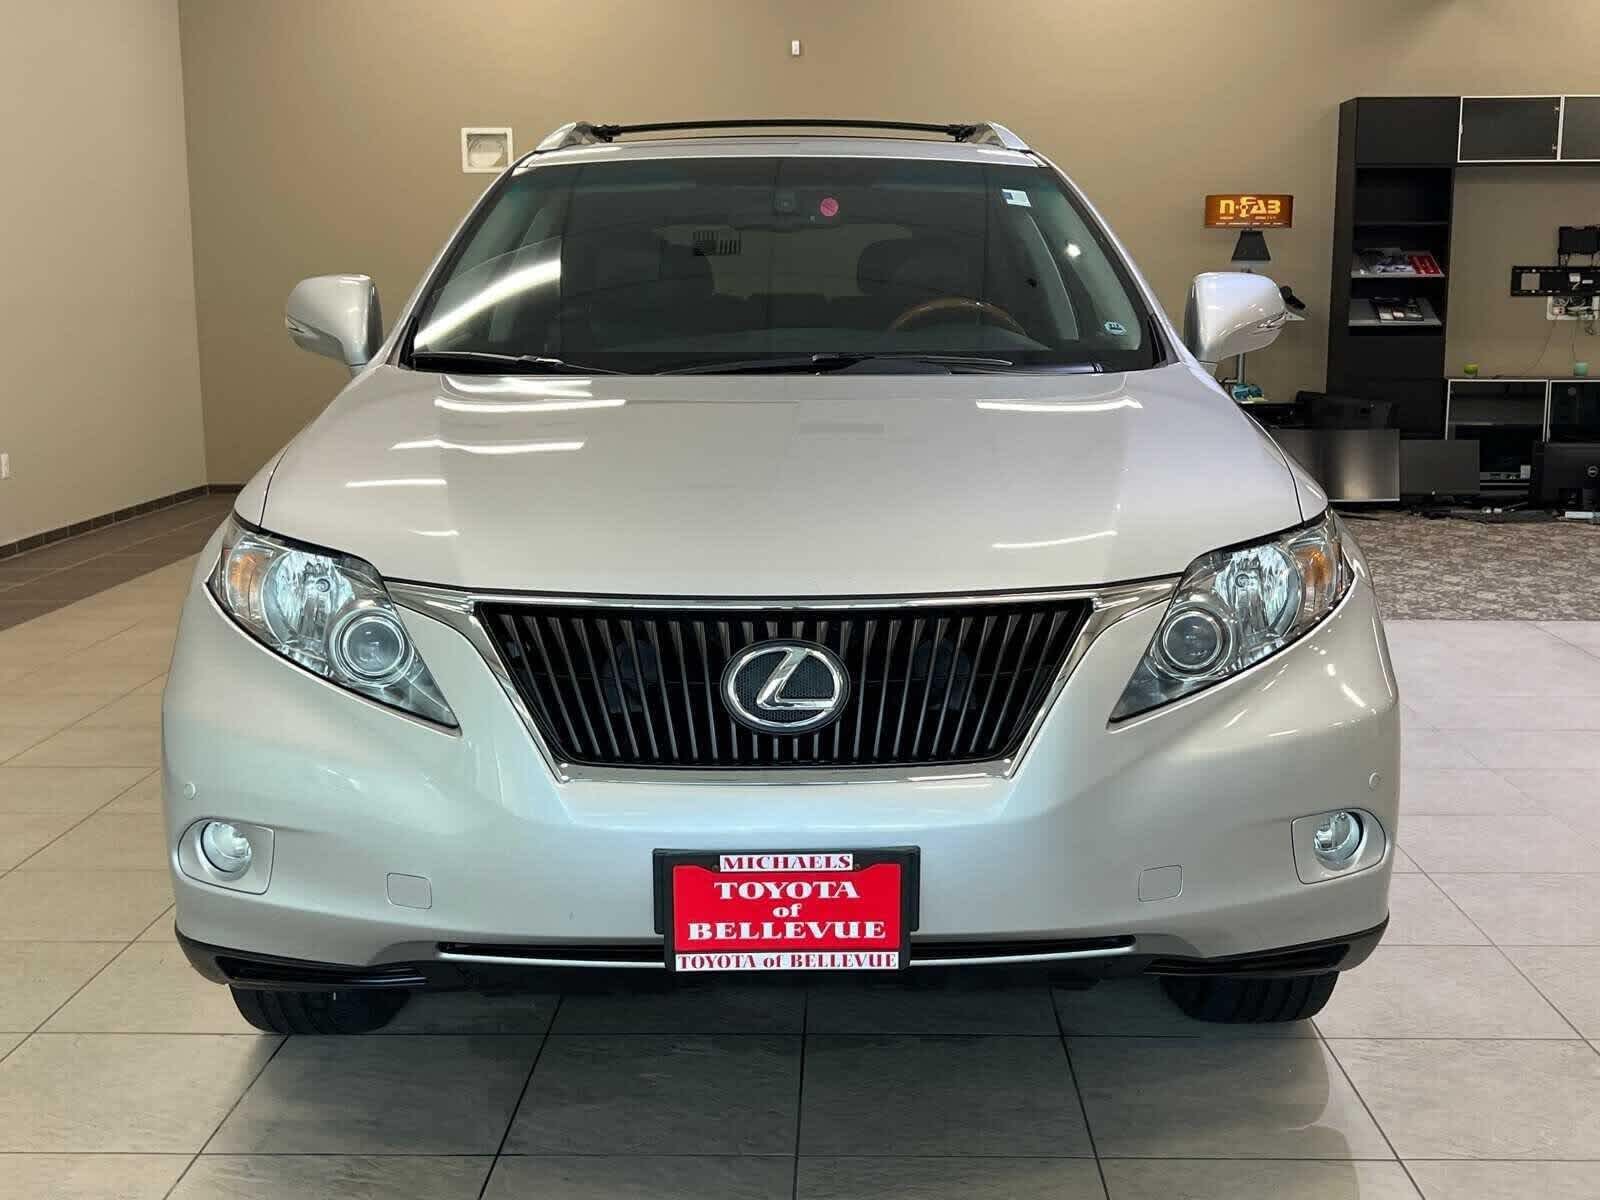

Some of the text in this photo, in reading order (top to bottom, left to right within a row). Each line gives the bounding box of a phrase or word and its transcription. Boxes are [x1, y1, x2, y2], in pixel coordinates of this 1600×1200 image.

[723, 854, 851, 870] MICHAELS
[714, 881, 860, 900] TOYOTA
[772, 903, 803, 918] of
[687, 921, 887, 941] BELLEVUE
[677, 953, 897, 969] TOYOTA of BELLEVUE
